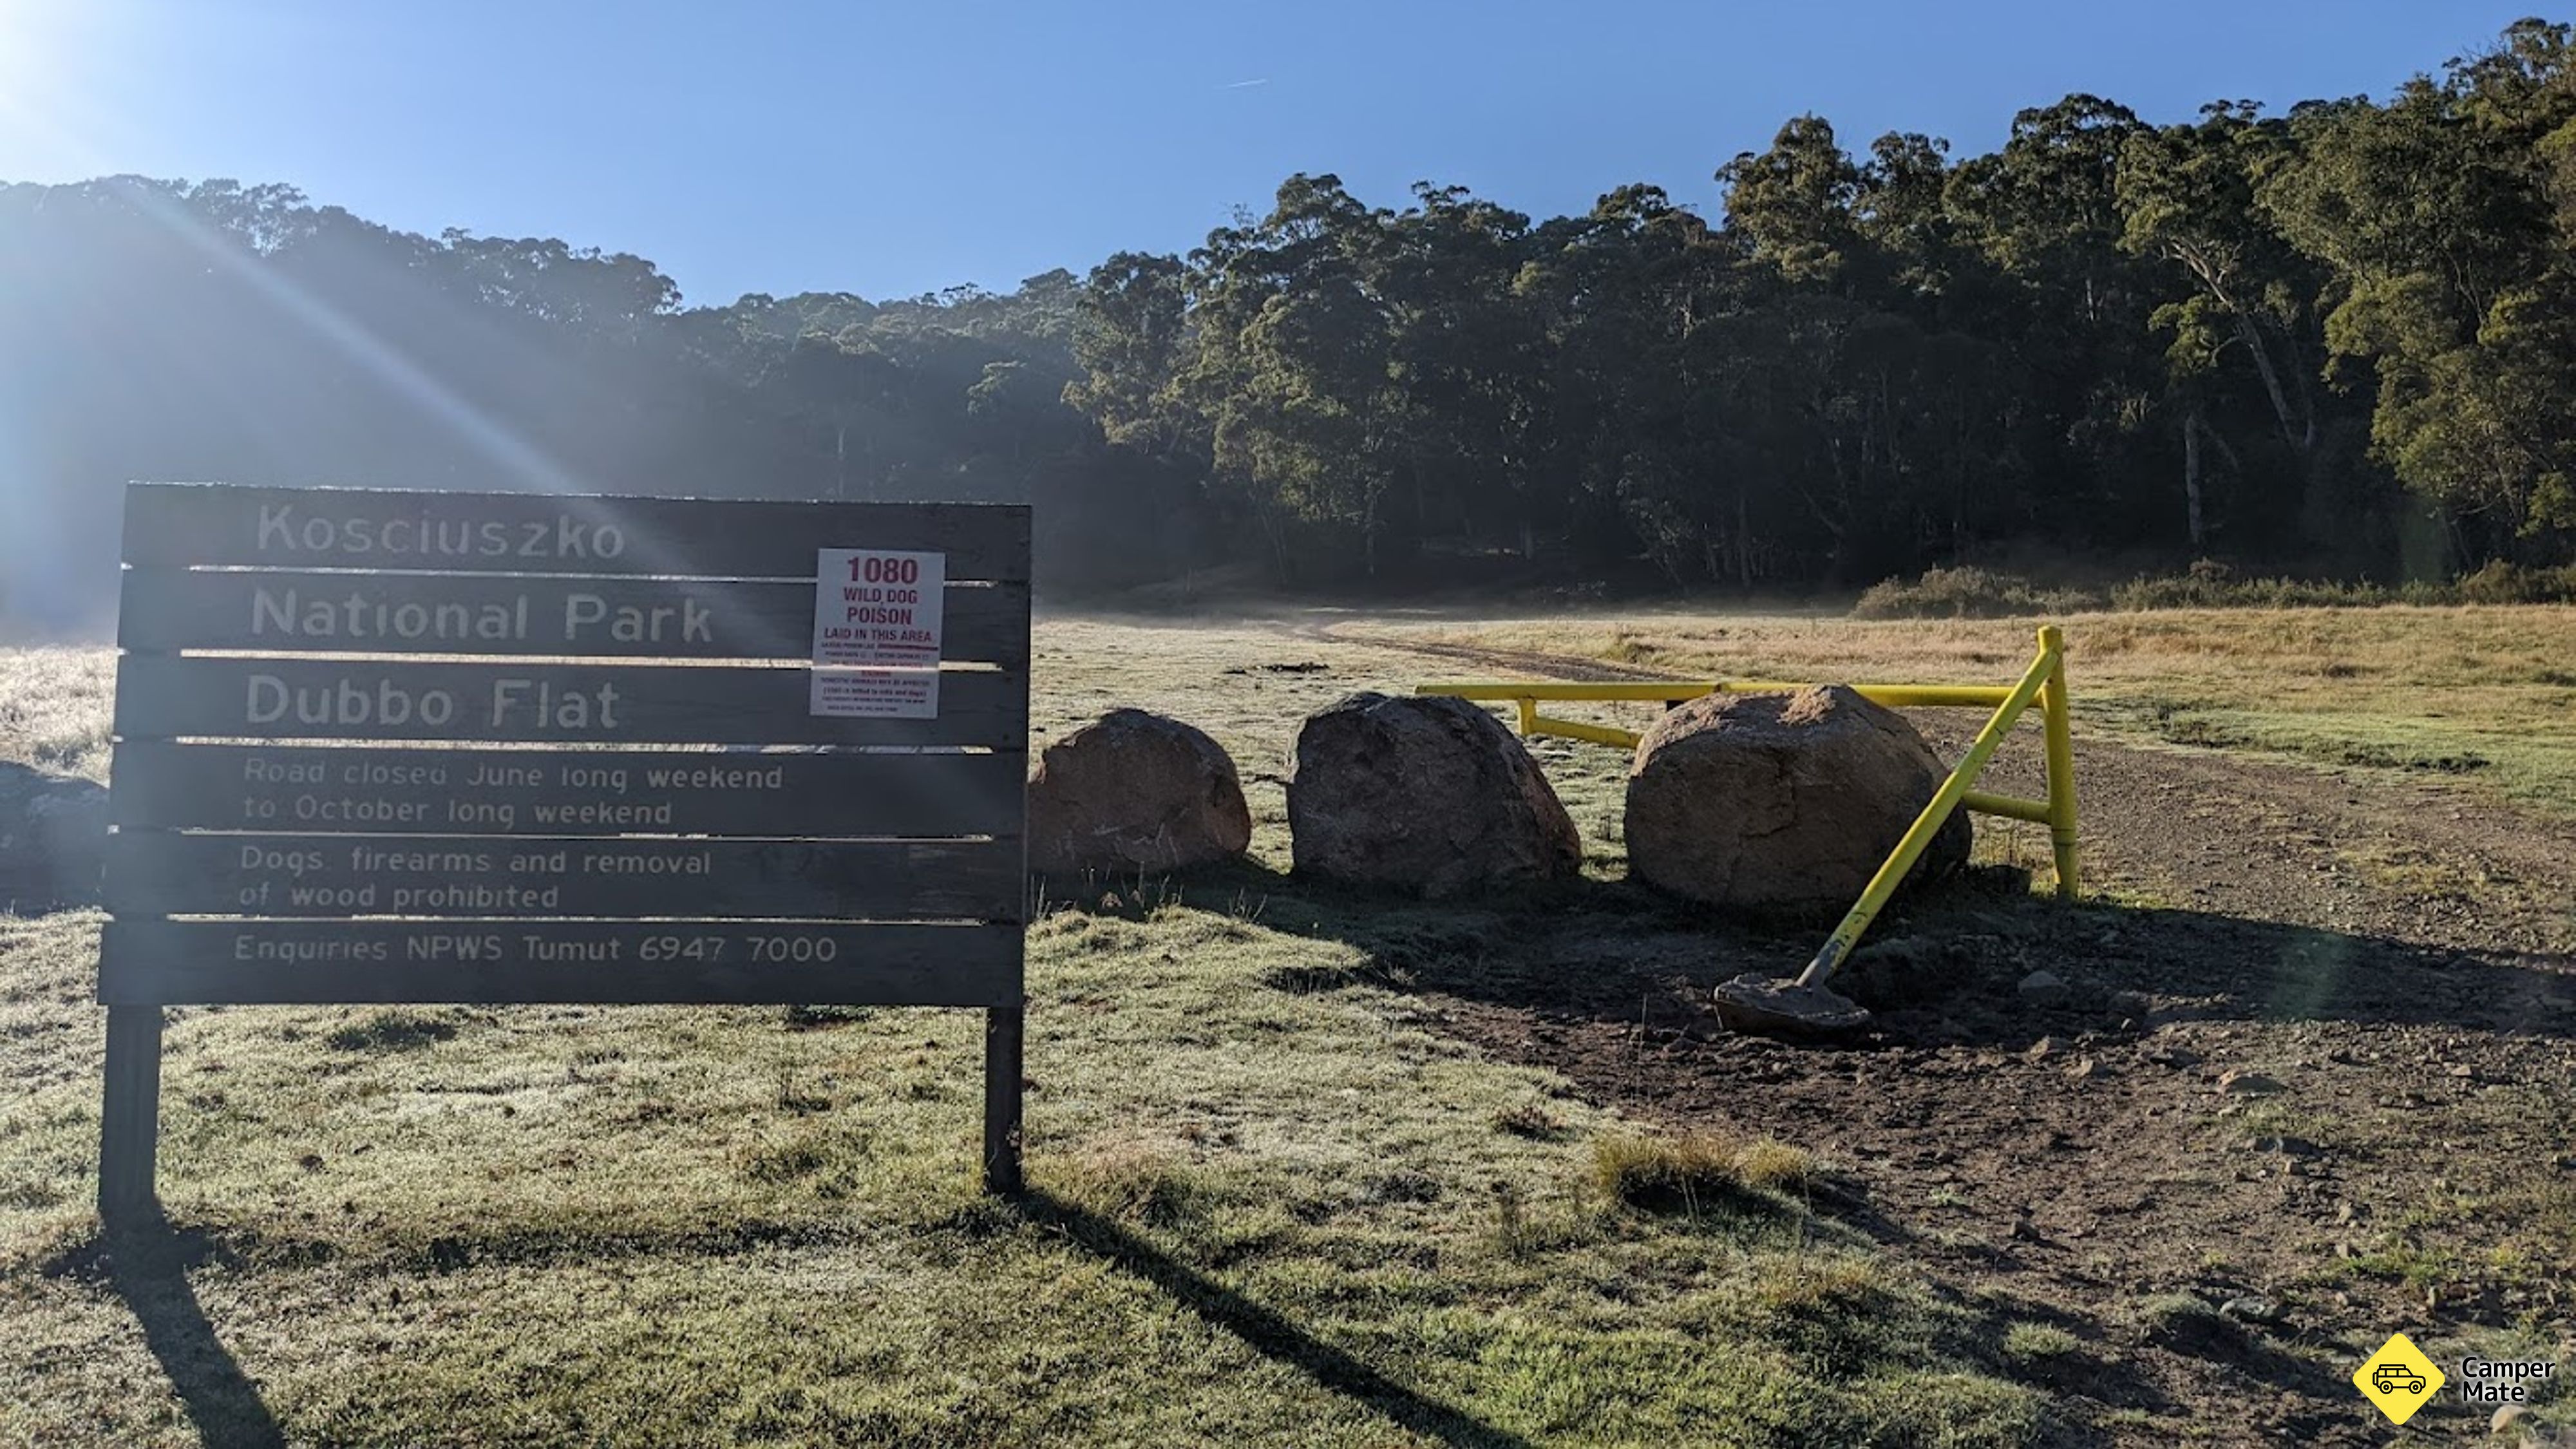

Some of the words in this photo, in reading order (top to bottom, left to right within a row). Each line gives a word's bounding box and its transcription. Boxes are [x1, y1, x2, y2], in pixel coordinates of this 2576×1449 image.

[258, 504, 625, 558] Kosciuszko
[848, 557, 918, 584] 1080
[887, 589, 918, 605] DOG
[252, 589, 528, 639] National
[565, 593, 713, 642] Park
[847, 607, 912, 625] POISON
[824, 627, 851, 639] LAID
[855, 629, 866, 640] IN
[872, 629, 897, 641] THIS
[902, 630, 932, 642] AREA
[246, 674, 453, 727] Dubbo
[492, 678, 620, 728] Flat
[244, 758, 324, 783] Road
[467, 762, 544, 787] June
[562, 766, 627, 793] long
[647, 766, 782, 789] weekend
[245, 796, 276, 819] to
[295, 795, 429, 822] October
[449, 799, 515, 829] long
[535, 802, 672, 824] weekend
[352, 846, 491, 872] firearms
[509, 850, 565, 873] and
[584, 851, 710, 874] removal
[240, 881, 269, 905] of
[291, 884, 375, 907] wood
[394, 884, 559, 912] prohibited
[235, 935, 386, 964] Enquiries
[407, 935, 502, 960] NPWS
[523, 935, 620, 961] Tumut
[639, 936, 725, 961] 6947
[747, 936, 837, 962] 7000
